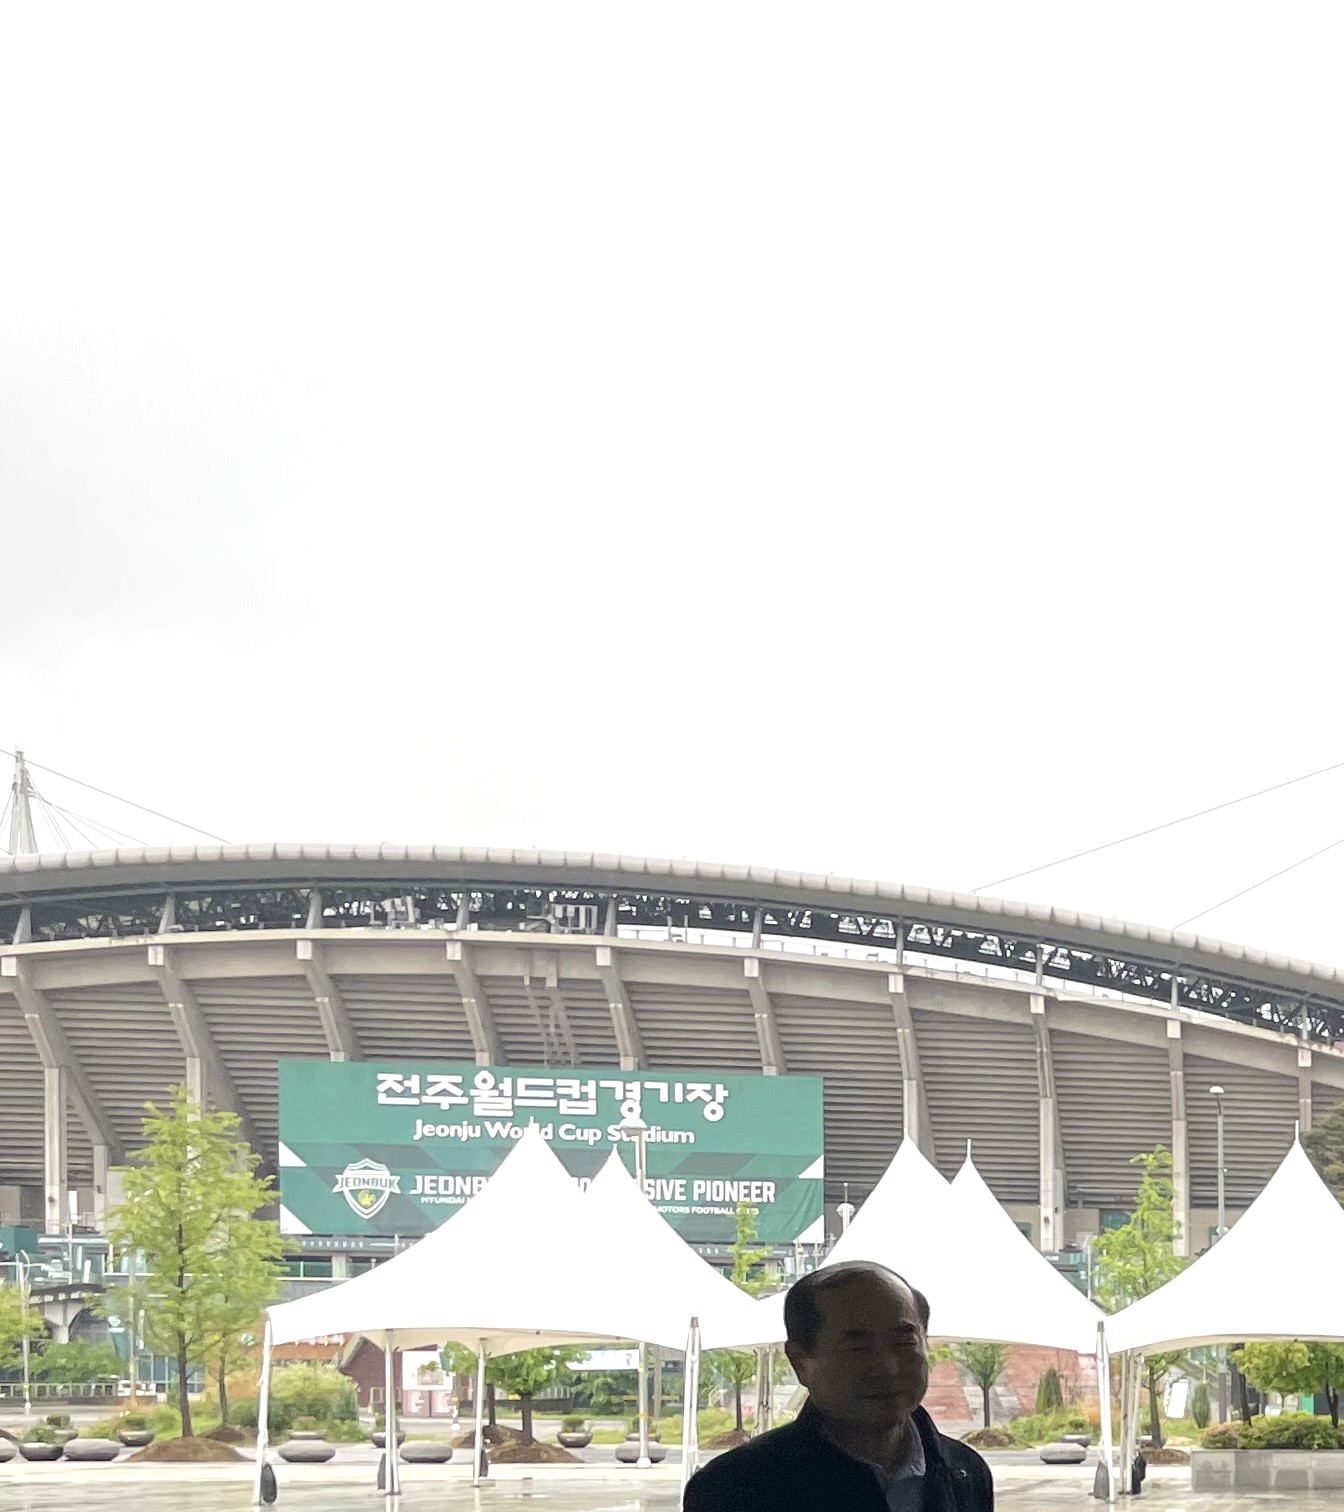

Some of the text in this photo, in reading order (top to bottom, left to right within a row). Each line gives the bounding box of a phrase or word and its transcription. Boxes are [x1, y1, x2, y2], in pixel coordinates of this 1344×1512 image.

[375, 1070, 730, 1122] 전주월드컵경기장
[413, 1119, 482, 1142] Jeonju
[558, 1123, 602, 1143] Cup
[607, 1125, 695, 1144] Stdium
[337, 1176, 396, 1189] JEONBUK
[693, 1180, 775, 1203] PIONEER
[691, 1206, 735, 1215] FOOTBALL
[735, 1207, 760, 1216] CB
